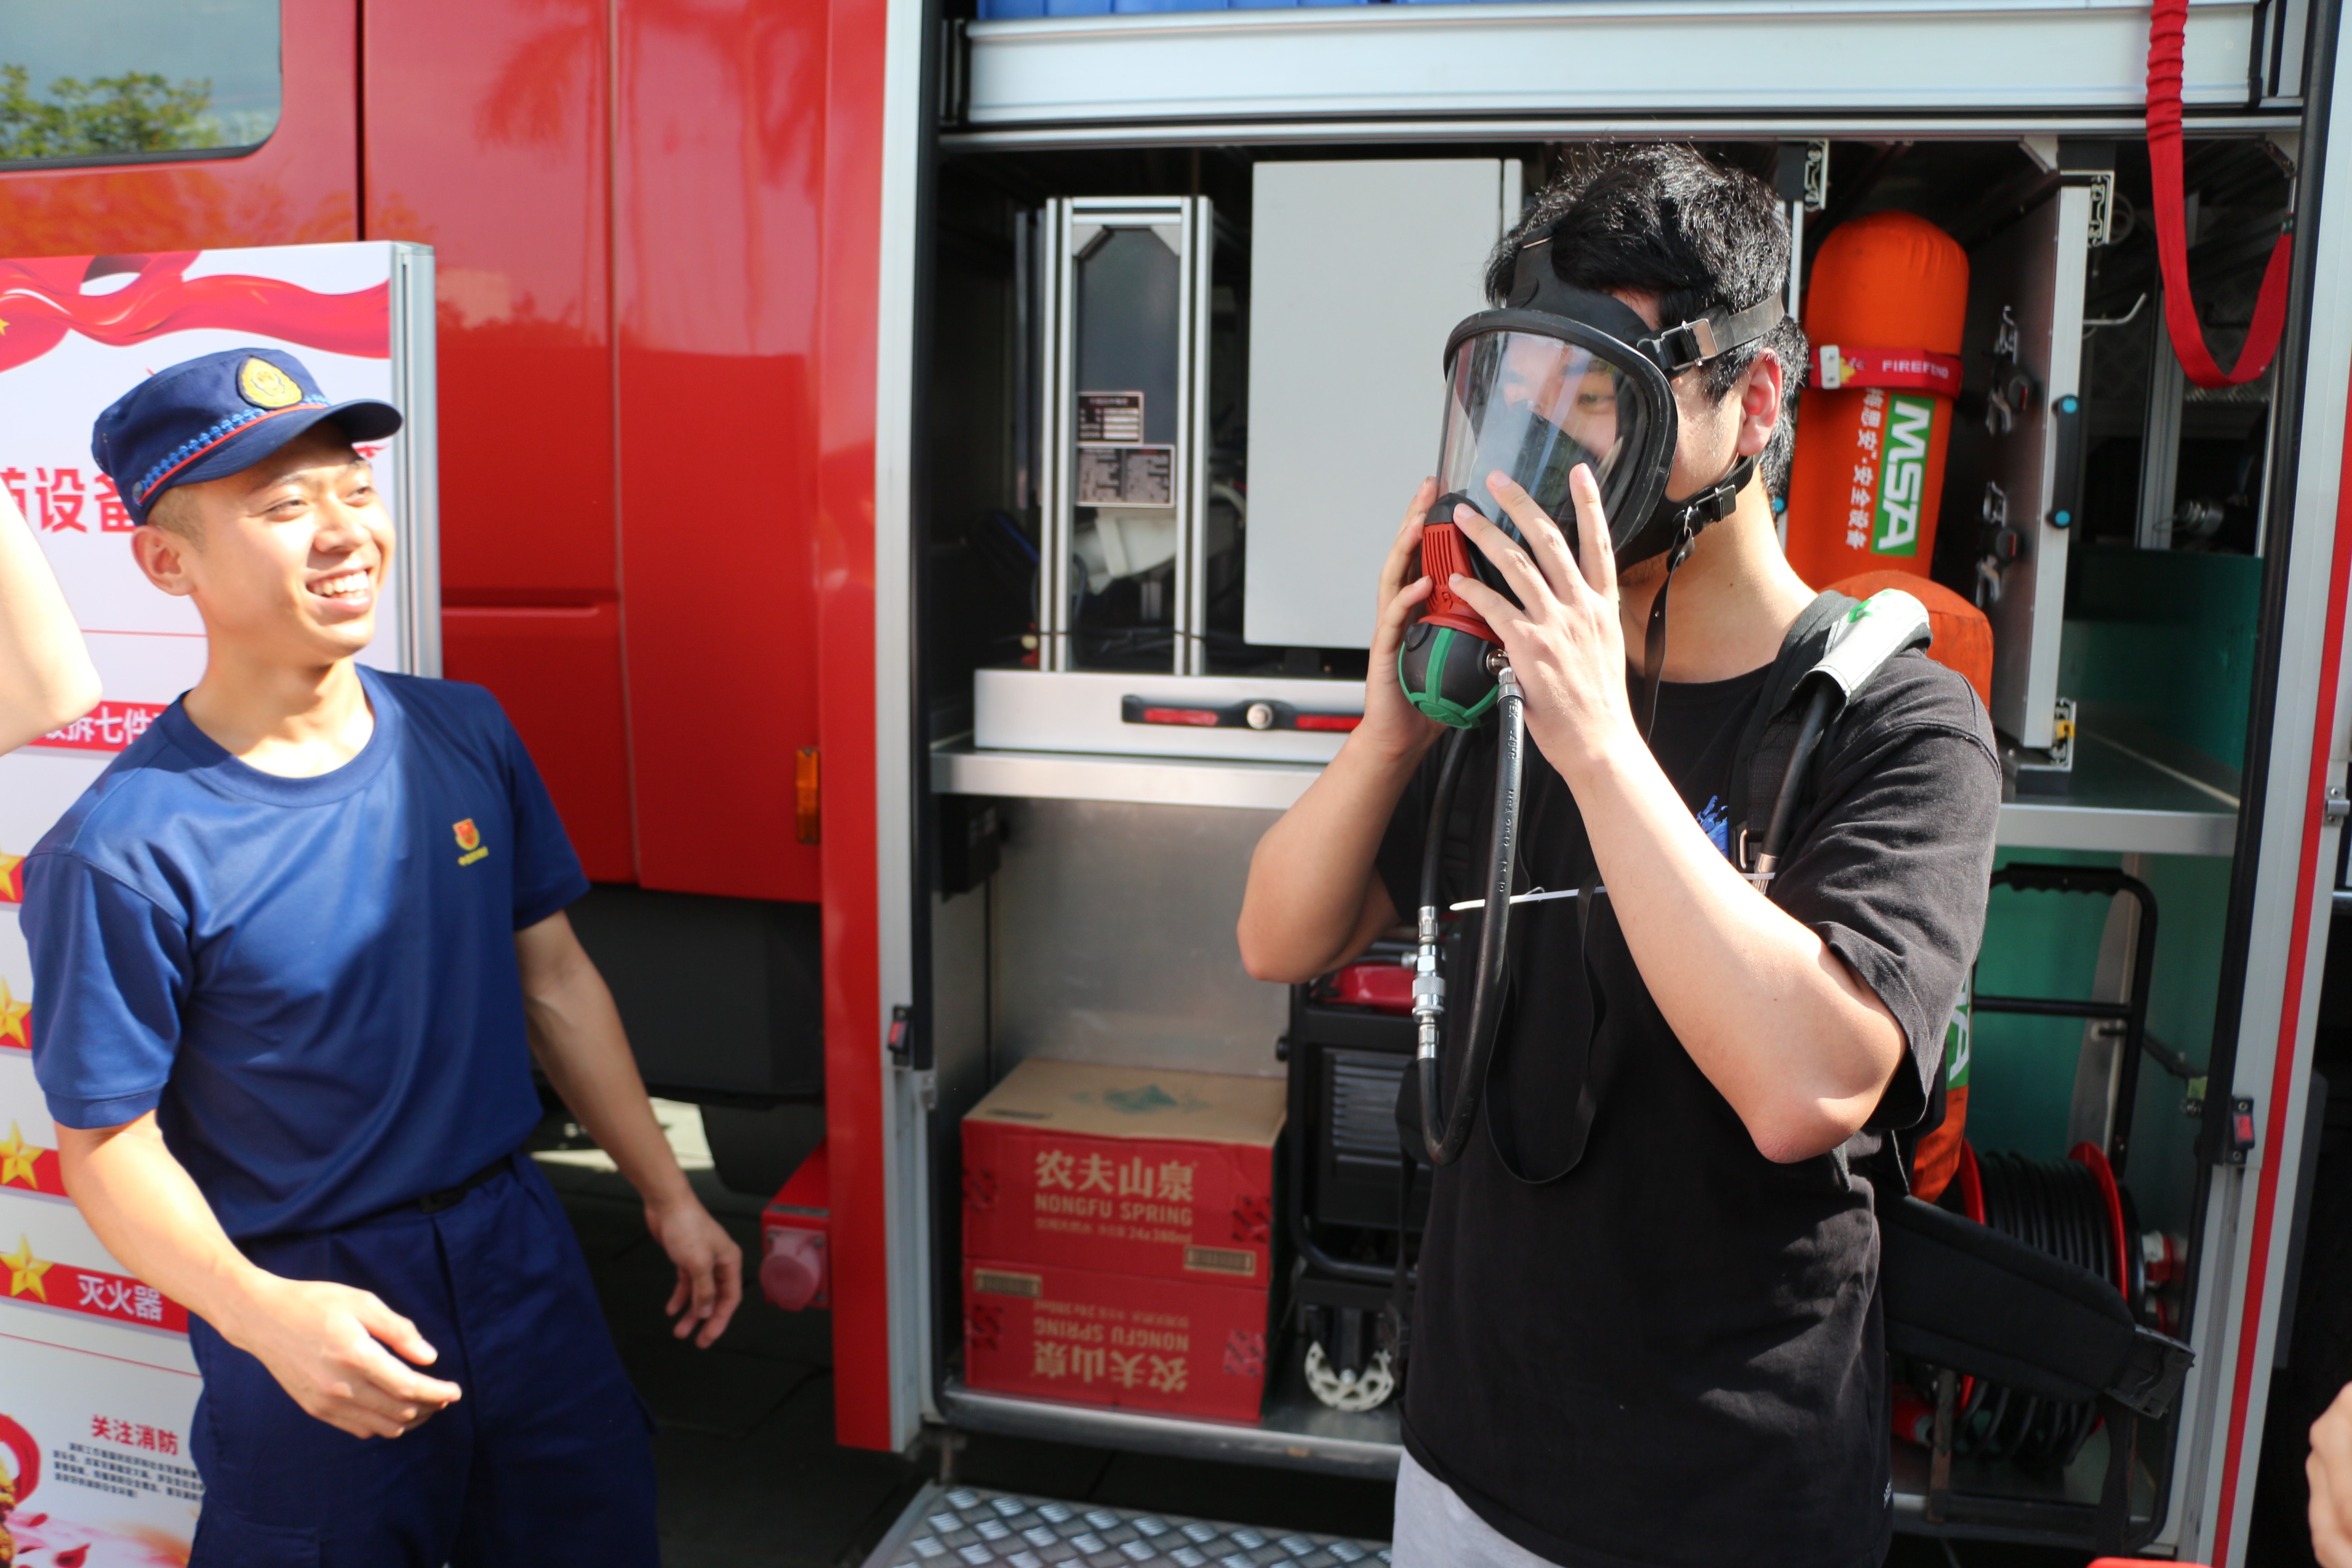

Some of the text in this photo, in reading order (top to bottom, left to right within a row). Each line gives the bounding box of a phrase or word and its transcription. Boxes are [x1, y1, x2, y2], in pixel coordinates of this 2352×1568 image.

[1877, 400, 1930, 550] MSA
[1035, 1150, 1194, 1202] 农夫山泉
[1034, 1193, 1113, 1219] NONGFU
[1119, 1200, 1193, 1226] SPRING
[78, 1274, 162, 1322] 灭火器
[1034, 1316, 1104, 1343] SPRING
[1110, 1325, 1190, 1352] NONGFU
[1034, 1339, 1189, 1393] 农夫山泉
[91, 1414, 178, 1456] 关注消防
